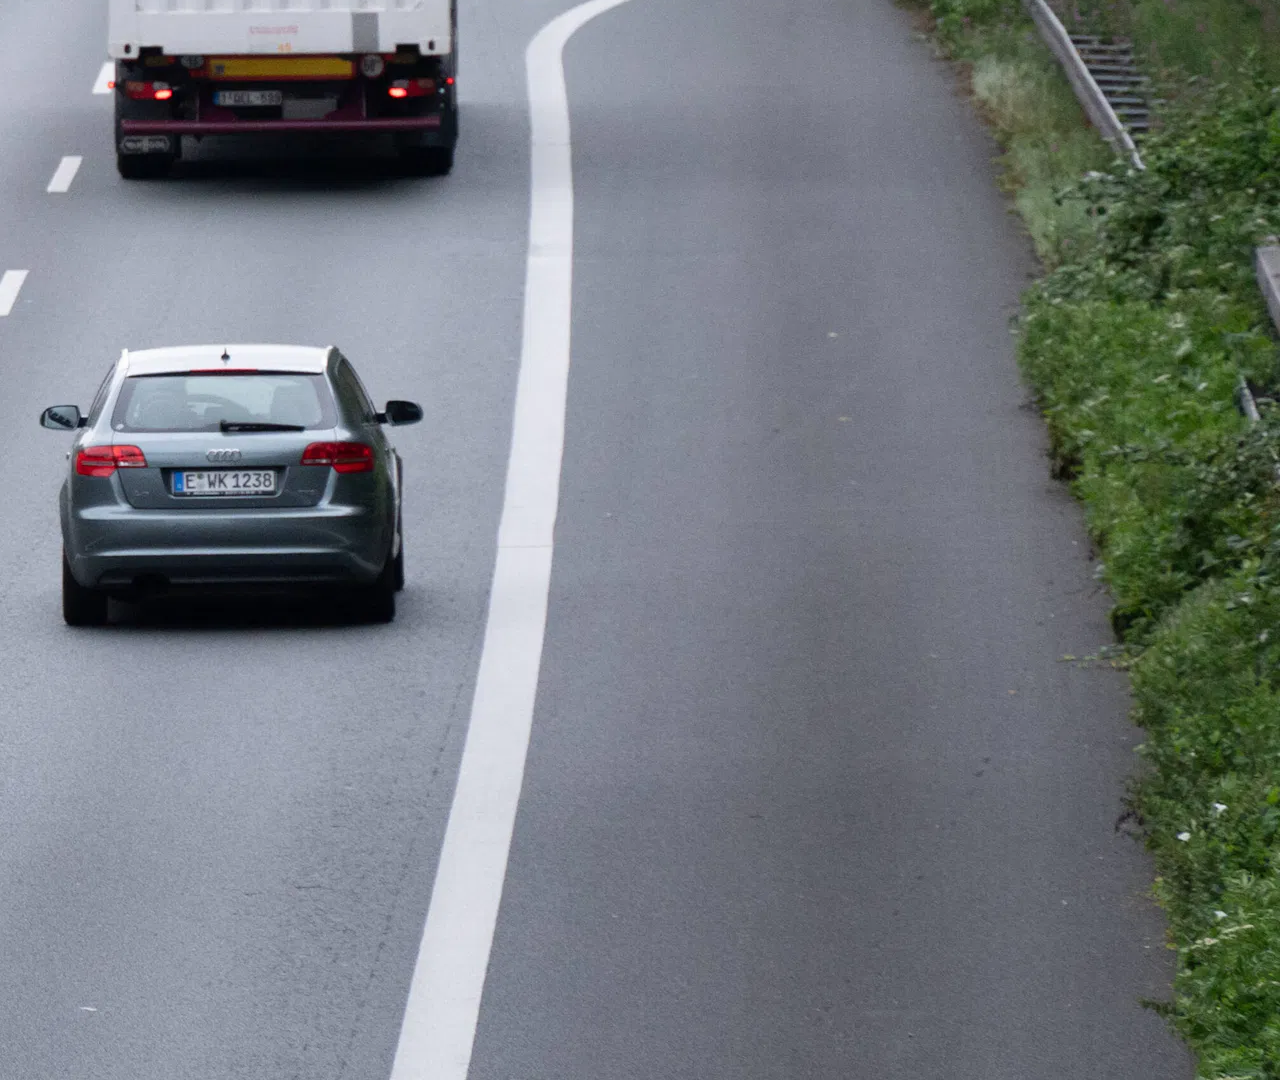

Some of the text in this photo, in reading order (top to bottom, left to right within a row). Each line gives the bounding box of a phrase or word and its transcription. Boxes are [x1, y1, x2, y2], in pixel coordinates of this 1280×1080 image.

[185, 472, 272, 489] E WK 1238
